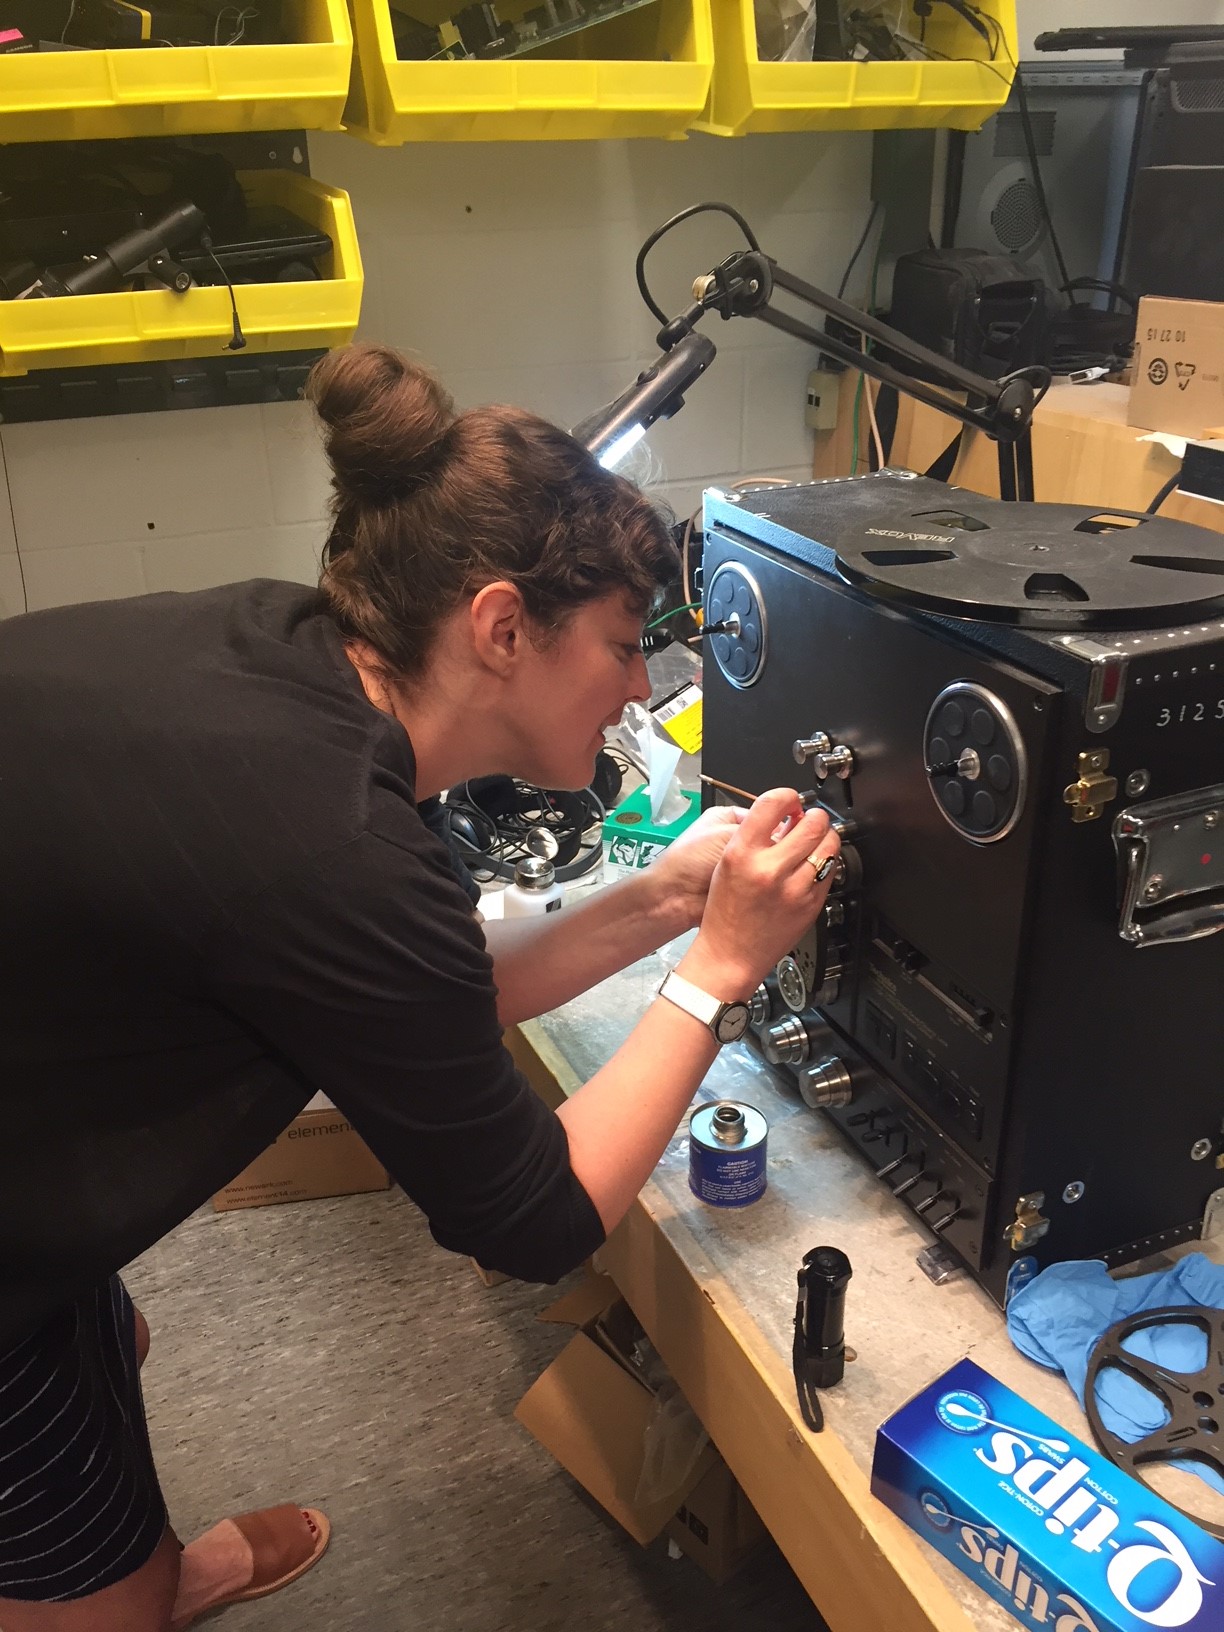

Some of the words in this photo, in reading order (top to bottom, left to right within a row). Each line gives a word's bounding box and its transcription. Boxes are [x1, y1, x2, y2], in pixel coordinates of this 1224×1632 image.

[1147, 328, 1158, 341] 15
[1160, 329, 1172, 342] 27
[1175, 330, 1186, 342] 10
[1038, 1443, 1066, 1465] SWABS
[998, 1480, 1045, 1517] COTON-TIGE
[1084, 1477, 1119, 1505] COTTON
[975, 1431, 1217, 1628] Q-tips
